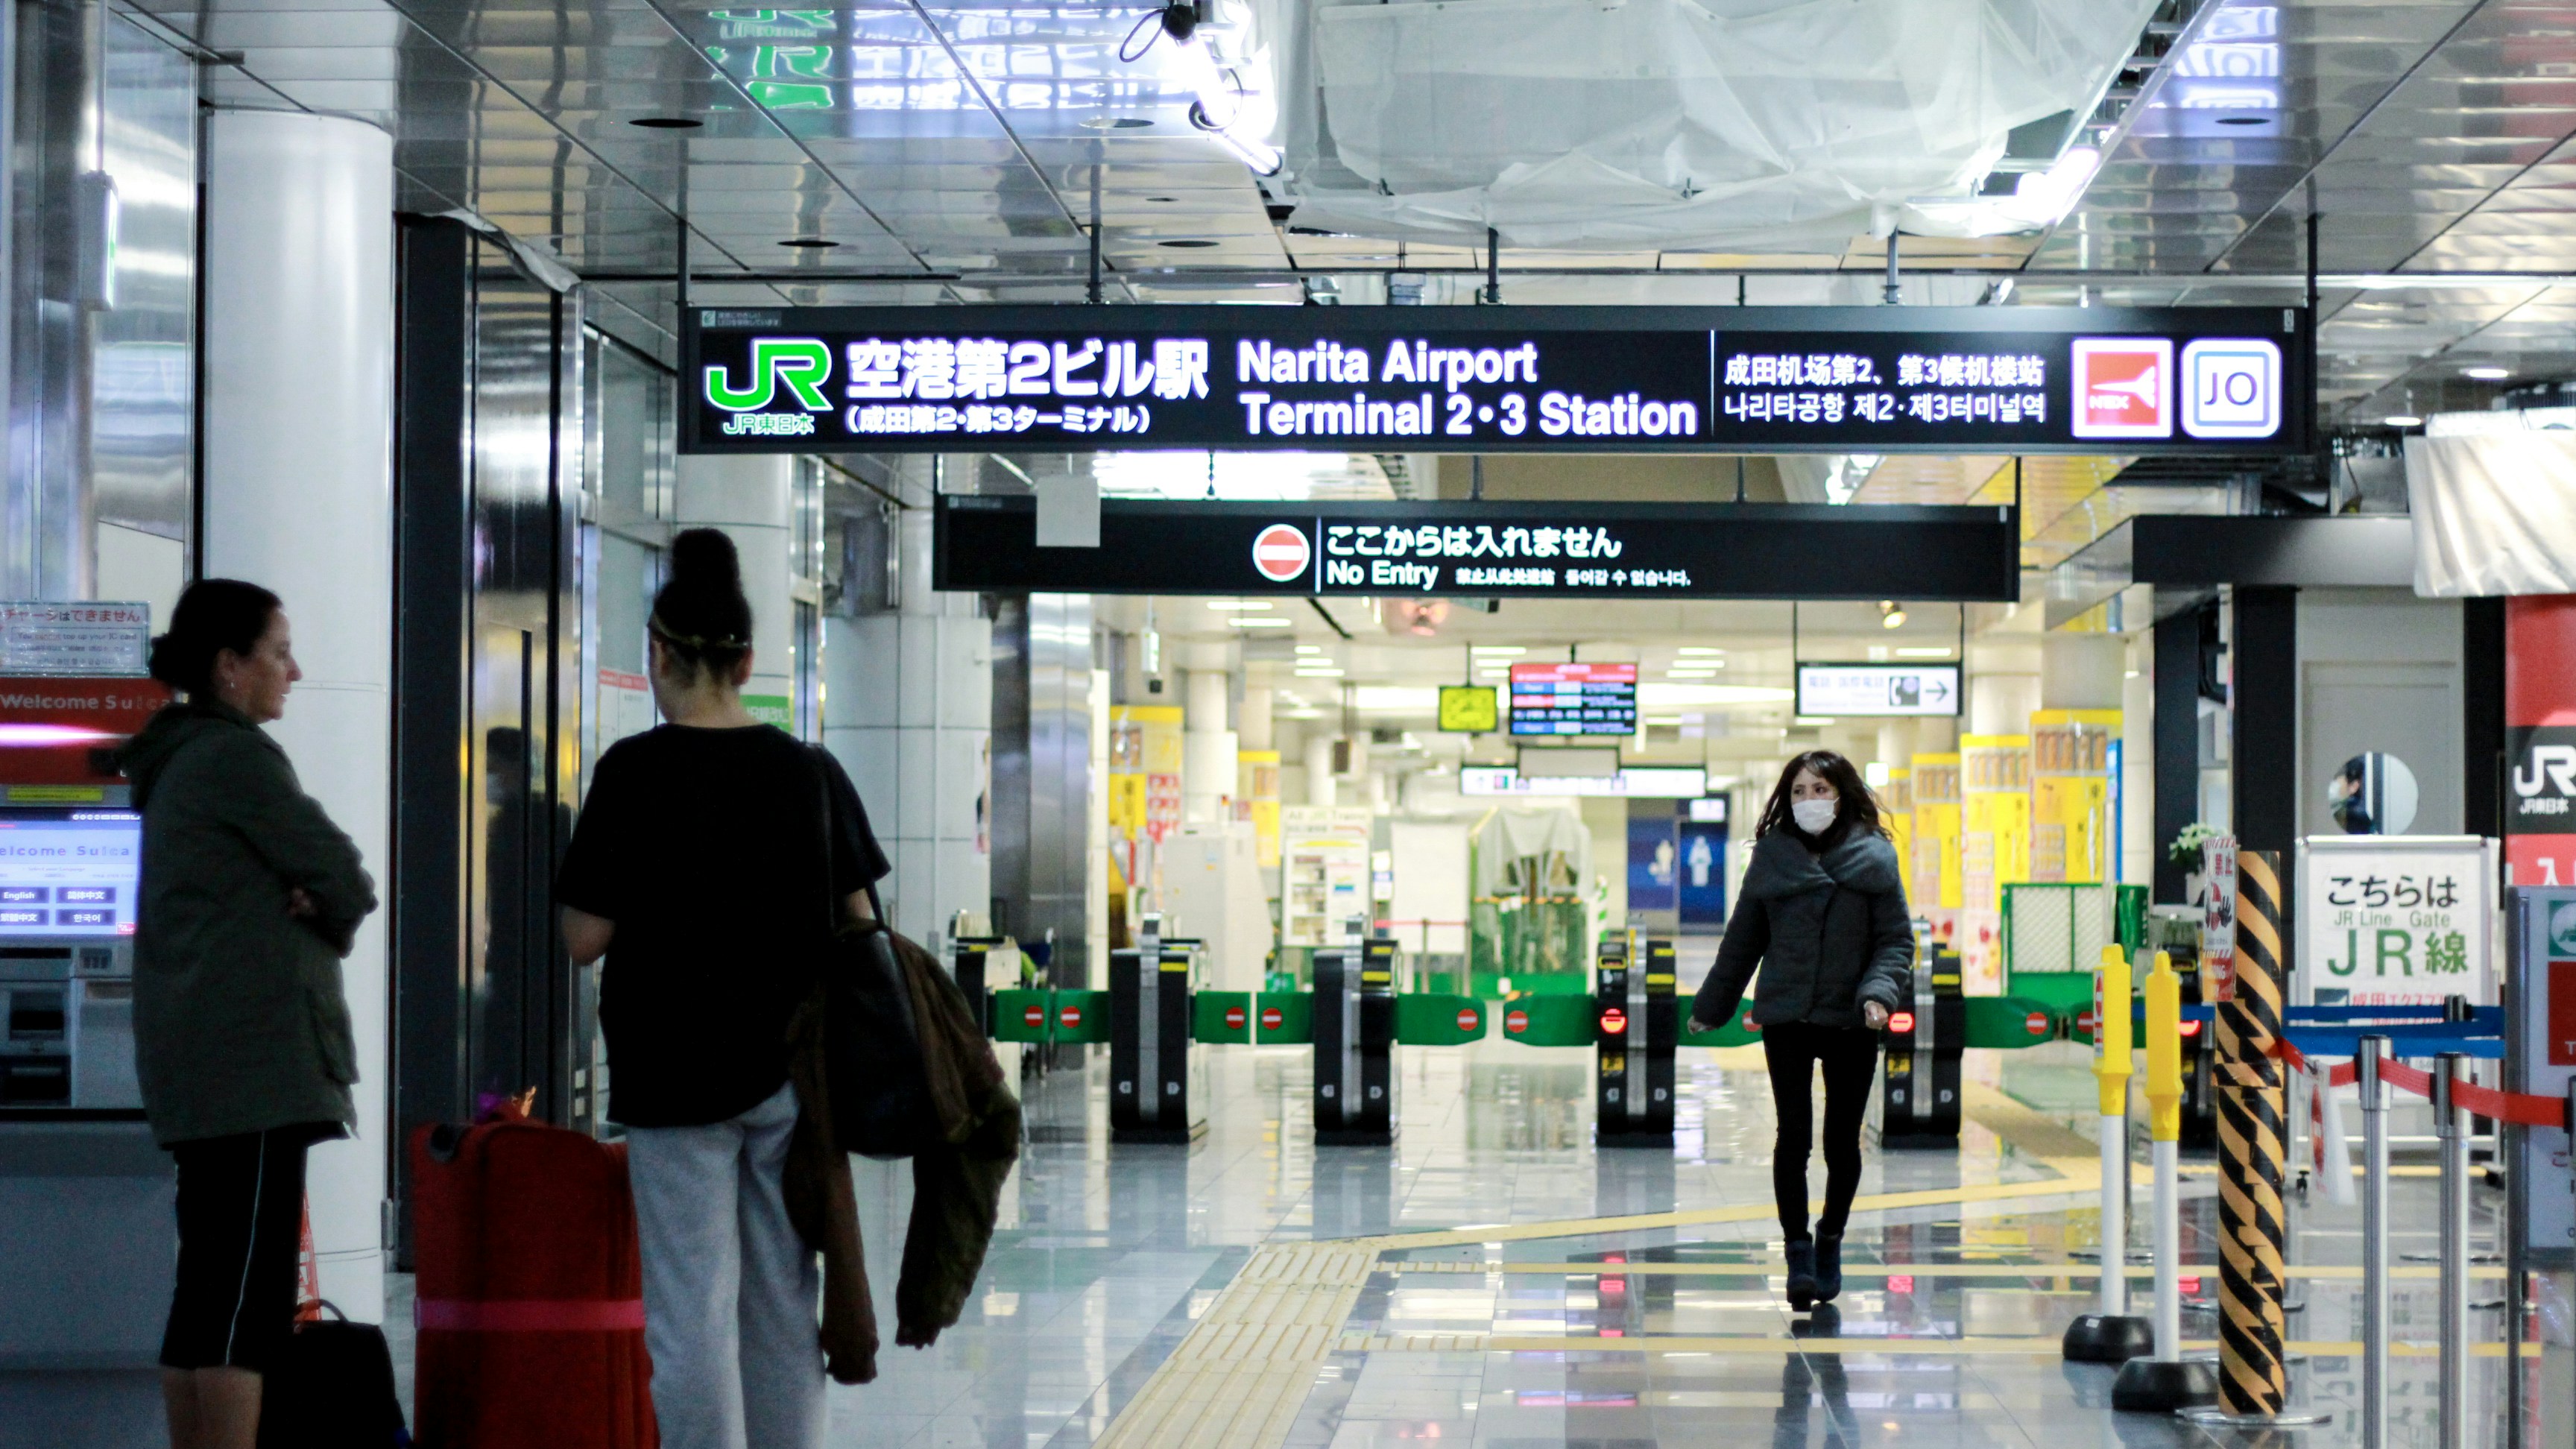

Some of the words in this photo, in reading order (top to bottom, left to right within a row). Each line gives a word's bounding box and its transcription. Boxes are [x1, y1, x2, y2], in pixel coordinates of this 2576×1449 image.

[704, 338, 833, 411] JR
[847, 338, 1209, 400] 空港第2ビル駅
[1238, 340, 1370, 383] Narita
[1382, 340, 1538, 393] Airport
[2089, 396, 2129, 409] NEX
[2204, 372, 2257, 405] JO
[722, 412, 815, 435] JR東日本
[1240, 394, 1433, 436] Terminal
[1540, 394, 1696, 436] Station
[1725, 393, 1846, 423] 나리타공항
[1327, 525, 1622, 558] ここからは入れません
[1327, 560, 1364, 585] No
[1372, 560, 1439, 591] Entry
[1565, 569, 1608, 586] 들어갈
[1612, 569, 1627, 586] 수
[1630, 569, 1690, 586] 없습니다.
[0, 694, 99, 709] Welcome
[2514, 745, 2576, 797] JR
[0, 846, 66, 856] elcome
[4, 892, 35, 900] English
[2328, 876, 2458, 908] こちらは
[74, 914, 101, 923] 한국어
[2334, 911, 2354, 926] JR
[2360, 911, 2393, 926] Line
[2409, 910, 2451, 927] Gate
[2327, 929, 2469, 976] JR線
